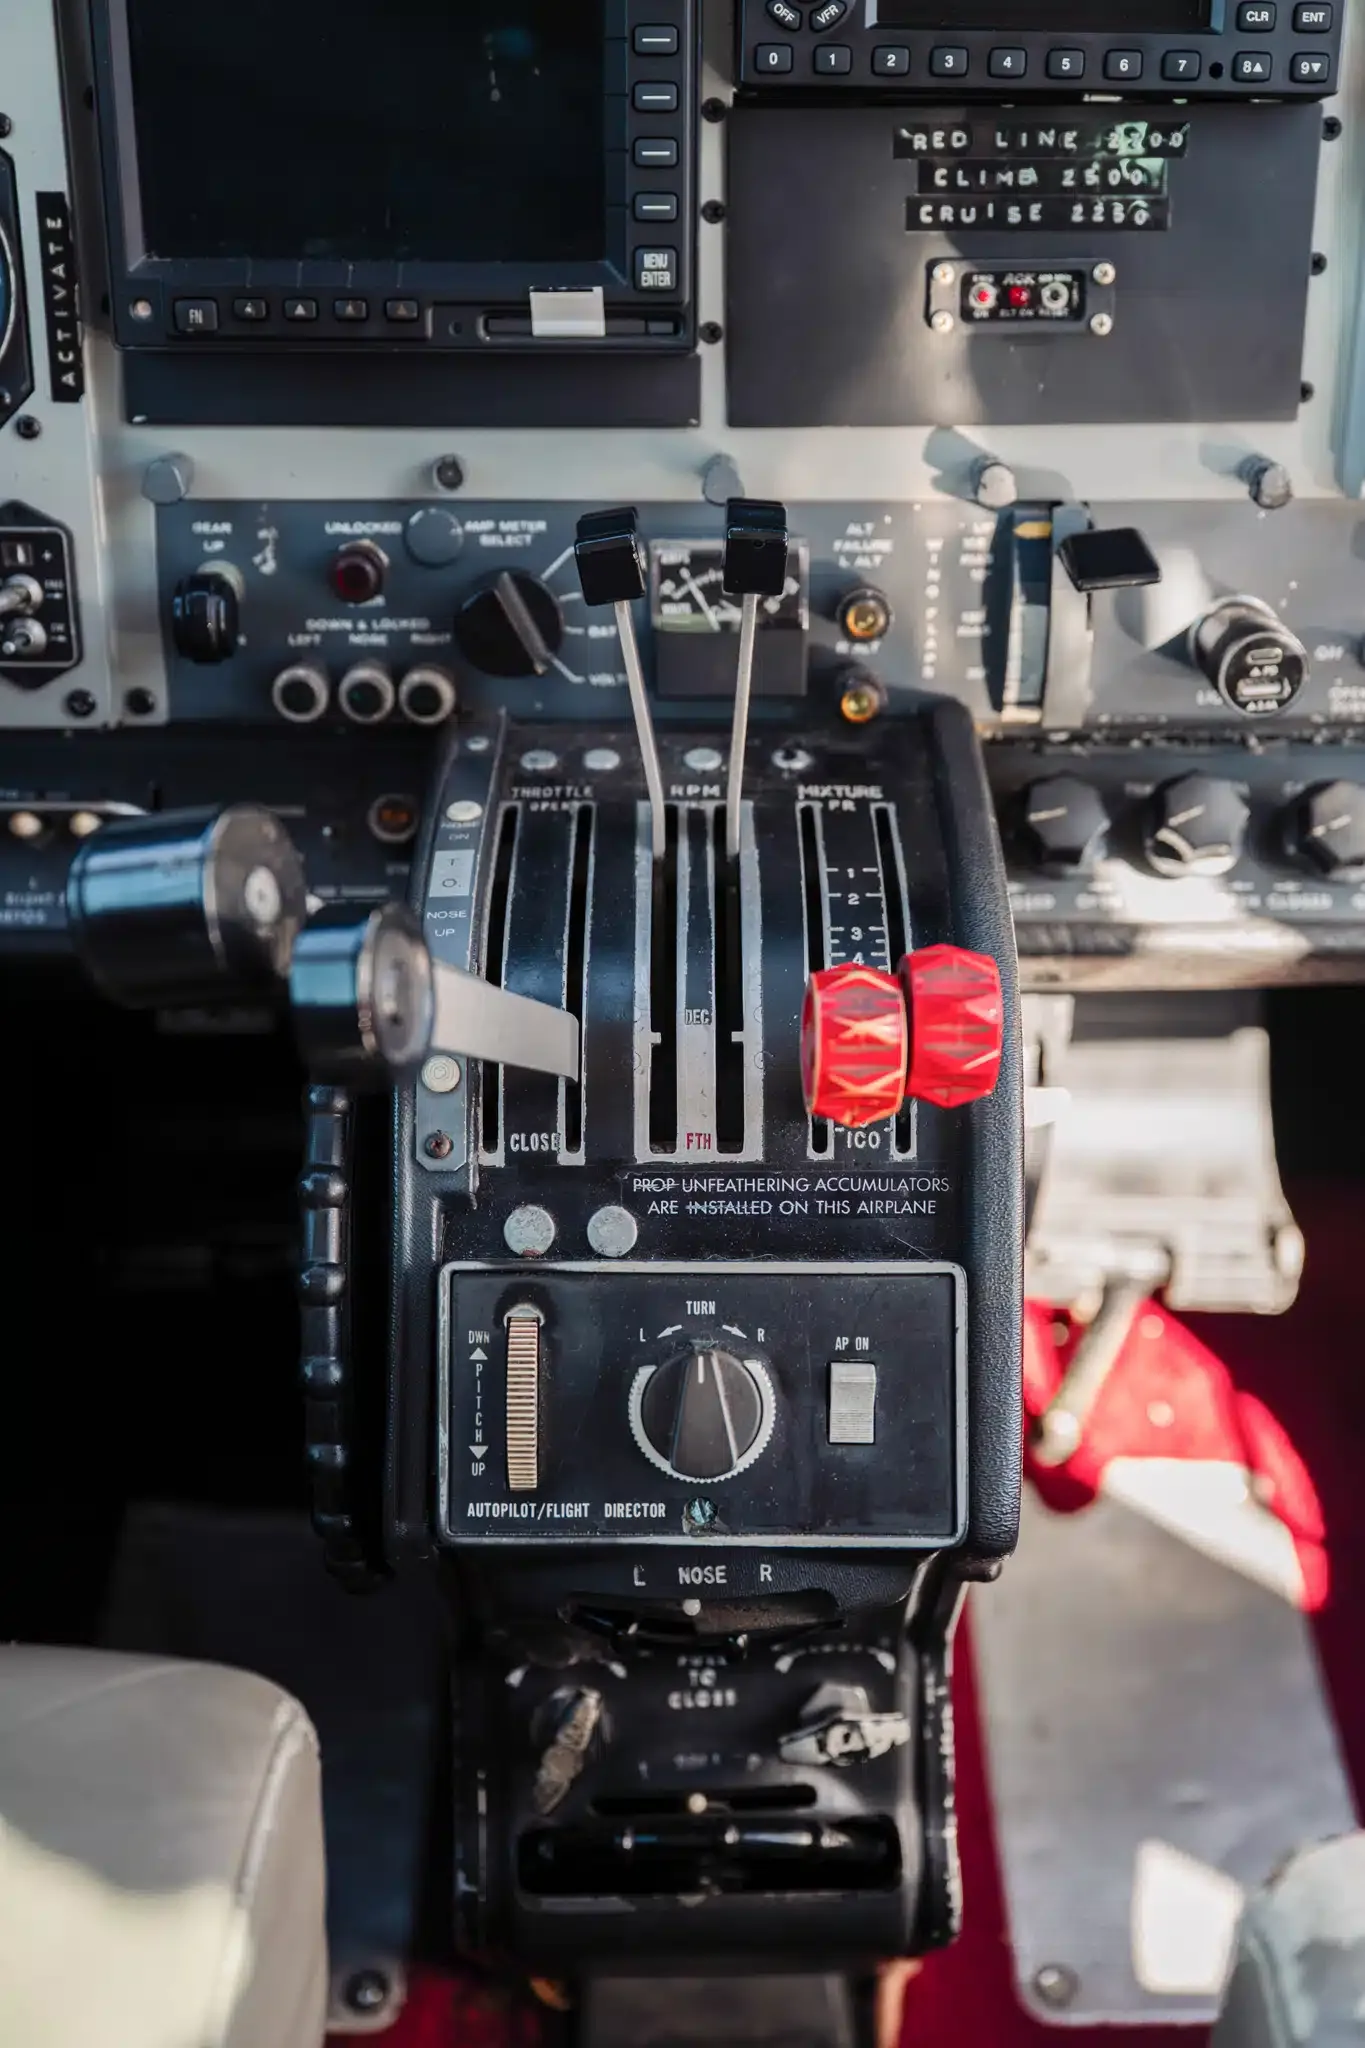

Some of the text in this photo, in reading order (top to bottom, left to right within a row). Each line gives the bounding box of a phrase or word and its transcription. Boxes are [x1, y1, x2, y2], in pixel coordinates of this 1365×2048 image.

[773, 3, 795, 23] OFF
[816, 4, 839, 24] VFR
[1246, 11, 1269, 22] CLR
[1302, 12, 1325, 23] ENT
[769, 53, 778, 65] 0
[829, 54, 836, 66] 1
[887, 55, 896, 67] 2
[945, 55, 954, 68] 3
[1003, 56, 1012, 68] 4
[1062, 58, 1070, 70] 5
[1119, 59, 1128, 71] 6
[1178, 60, 1187, 72] 7
[1242, 61, 1251, 73] 8
[1301, 62, 1309, 75] 9
[913, 130, 967, 150] RED
[996, 130, 1077, 149] LINE
[934, 167, 1037, 187] CLIMB
[919, 203, 1042, 224] CRUISE
[641, 271, 671, 287] ENTER
[46, 217, 75, 387] ACTIVATE
[189, 309, 203, 324] FN
[325, 520, 401, 534] UNLOCKED
[499, 520, 547, 532] METER
[511, 786, 593, 799] THROTTLE
[670, 784, 720, 797] RPM
[798, 784, 883, 799] MIXTURE
[847, 868, 855, 878] 1
[848, 893, 859, 905] 2
[427, 910, 468, 920] NOSE
[434, 928, 456, 937] UP
[851, 927, 862, 940] 3
[852, 952, 864, 966] 4
[510, 1132, 561, 1152] CLOSE
[686, 1132, 712, 1150] FTH
[847, 1130, 880, 1149] ICO
[633, 1177, 950, 1193] PROP UNFEATHERING ACCUMULATORS
[648, 1200, 937, 1215] ARE INSTALLED ON THIS AIRPLANE
[686, 1300, 716, 1315] TURN
[468, 1330, 490, 1344] DWN
[639, 1328, 646, 1342] L
[757, 1328, 765, 1342] R
[835, 1337, 869, 1351] AP ON
[475, 1363, 483, 1443] PITCH
[471, 1462, 486, 1476] UP
[467, 1502, 666, 1520] AUTOPILOT/FLIGHT DIRECTOR
[633, 1564, 773, 1587] L NOSE R
